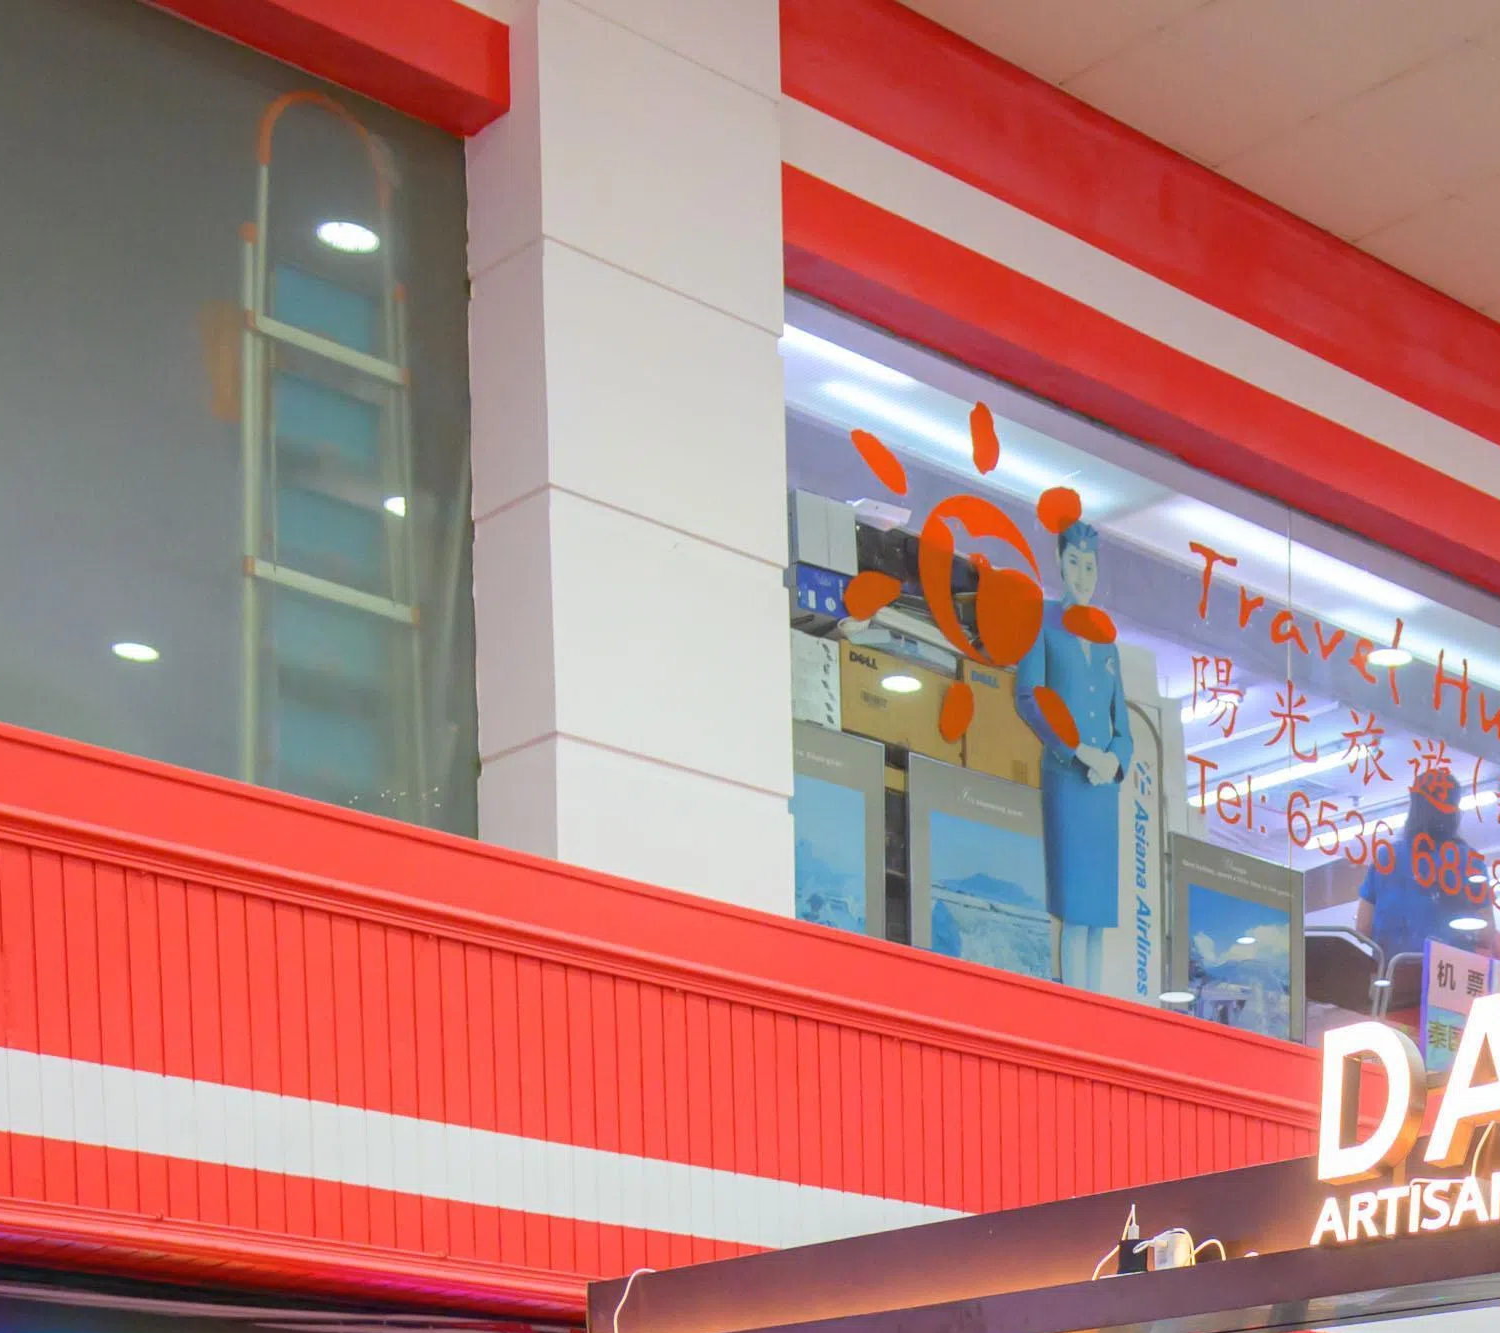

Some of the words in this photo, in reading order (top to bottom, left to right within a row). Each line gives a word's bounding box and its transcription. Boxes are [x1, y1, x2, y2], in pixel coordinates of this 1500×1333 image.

[849, 650, 879, 671] DELL
[1189, 541, 1405, 705] Travel
[1132, 800, 1150, 891] Asiana
[1187, 755, 1266, 833] Tel:
[1287, 790, 1396, 876] 6536
[1132, 898, 1150, 997] Airlines
